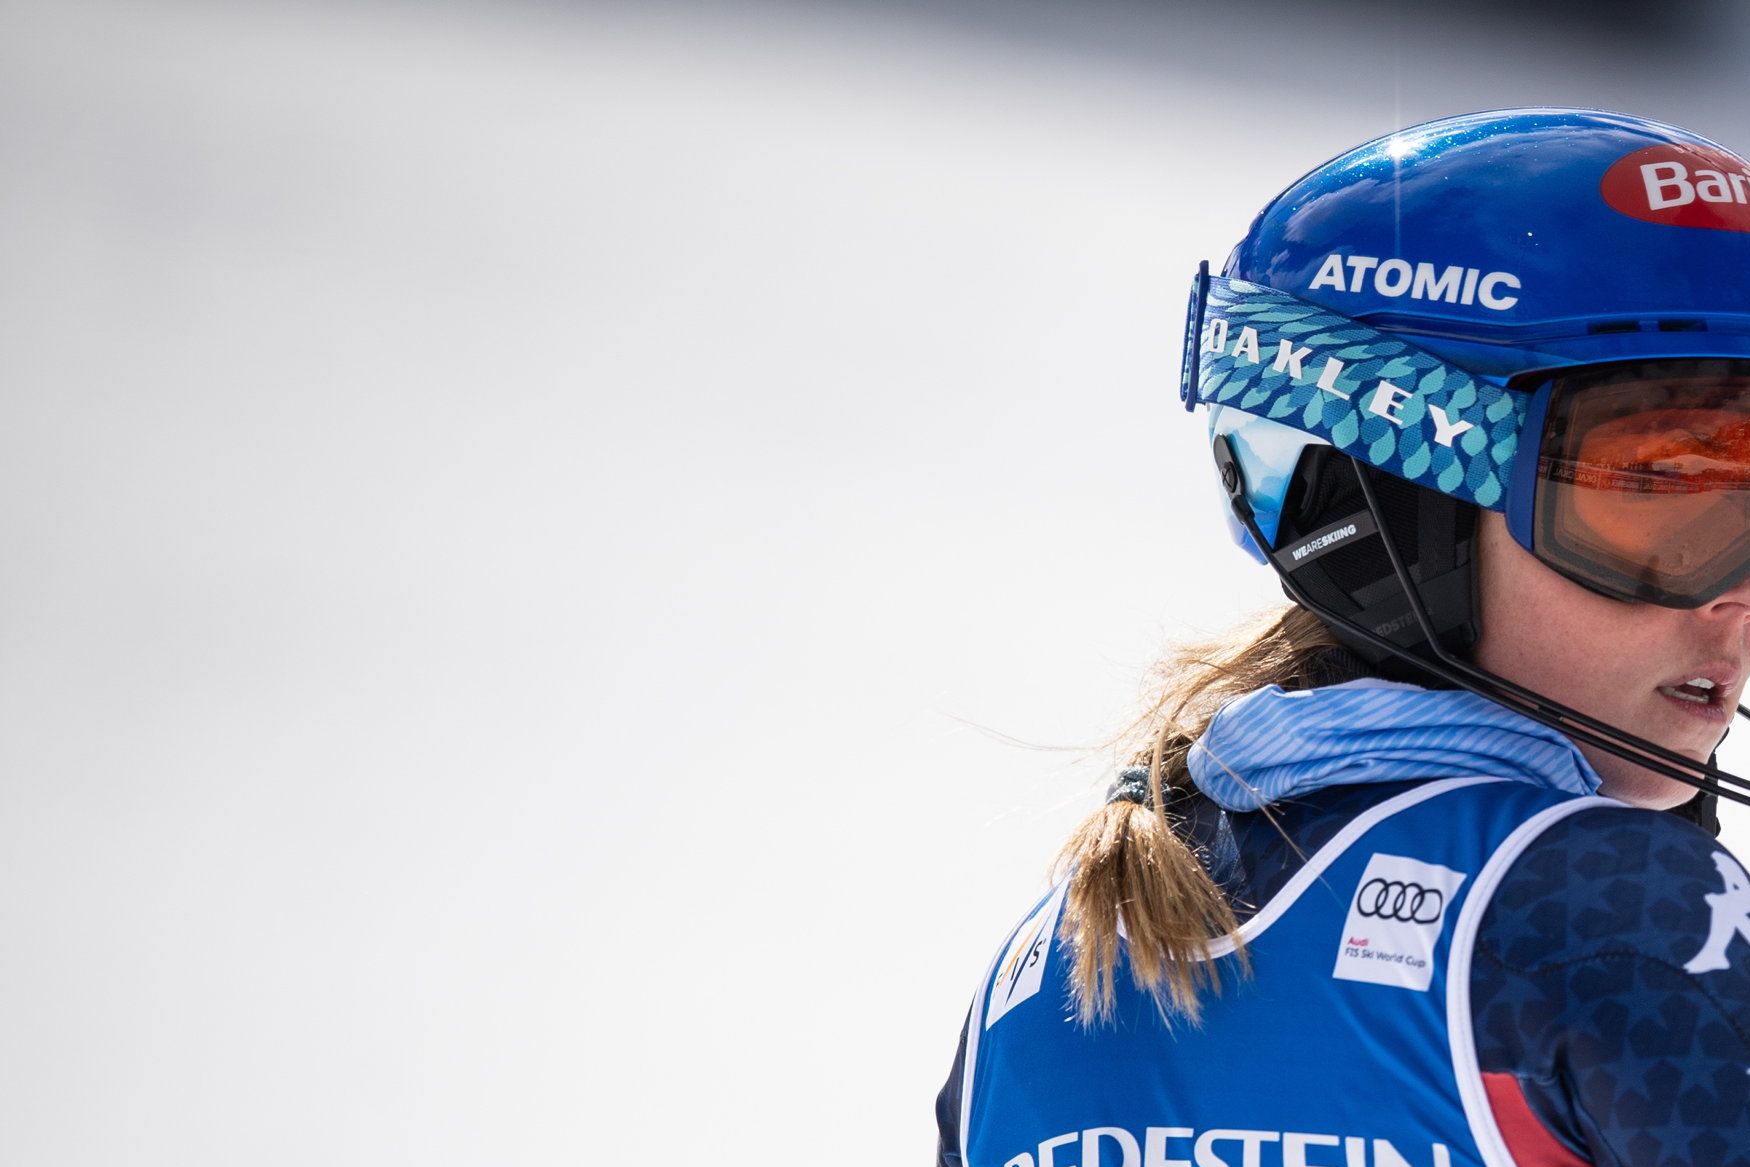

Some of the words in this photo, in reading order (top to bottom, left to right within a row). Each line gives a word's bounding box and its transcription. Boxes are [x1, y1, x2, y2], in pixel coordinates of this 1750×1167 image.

[1309, 254, 1522, 311] ATOMIC
[1207, 318, 1474, 448] OAKLEY
[1345, 947, 1359, 958] FIS
[1361, 949, 1374, 959] Ski
[1376, 951, 1404, 963] World
[1405, 955, 1426, 969] Cup
[1348, 936, 1369, 947] Audi
